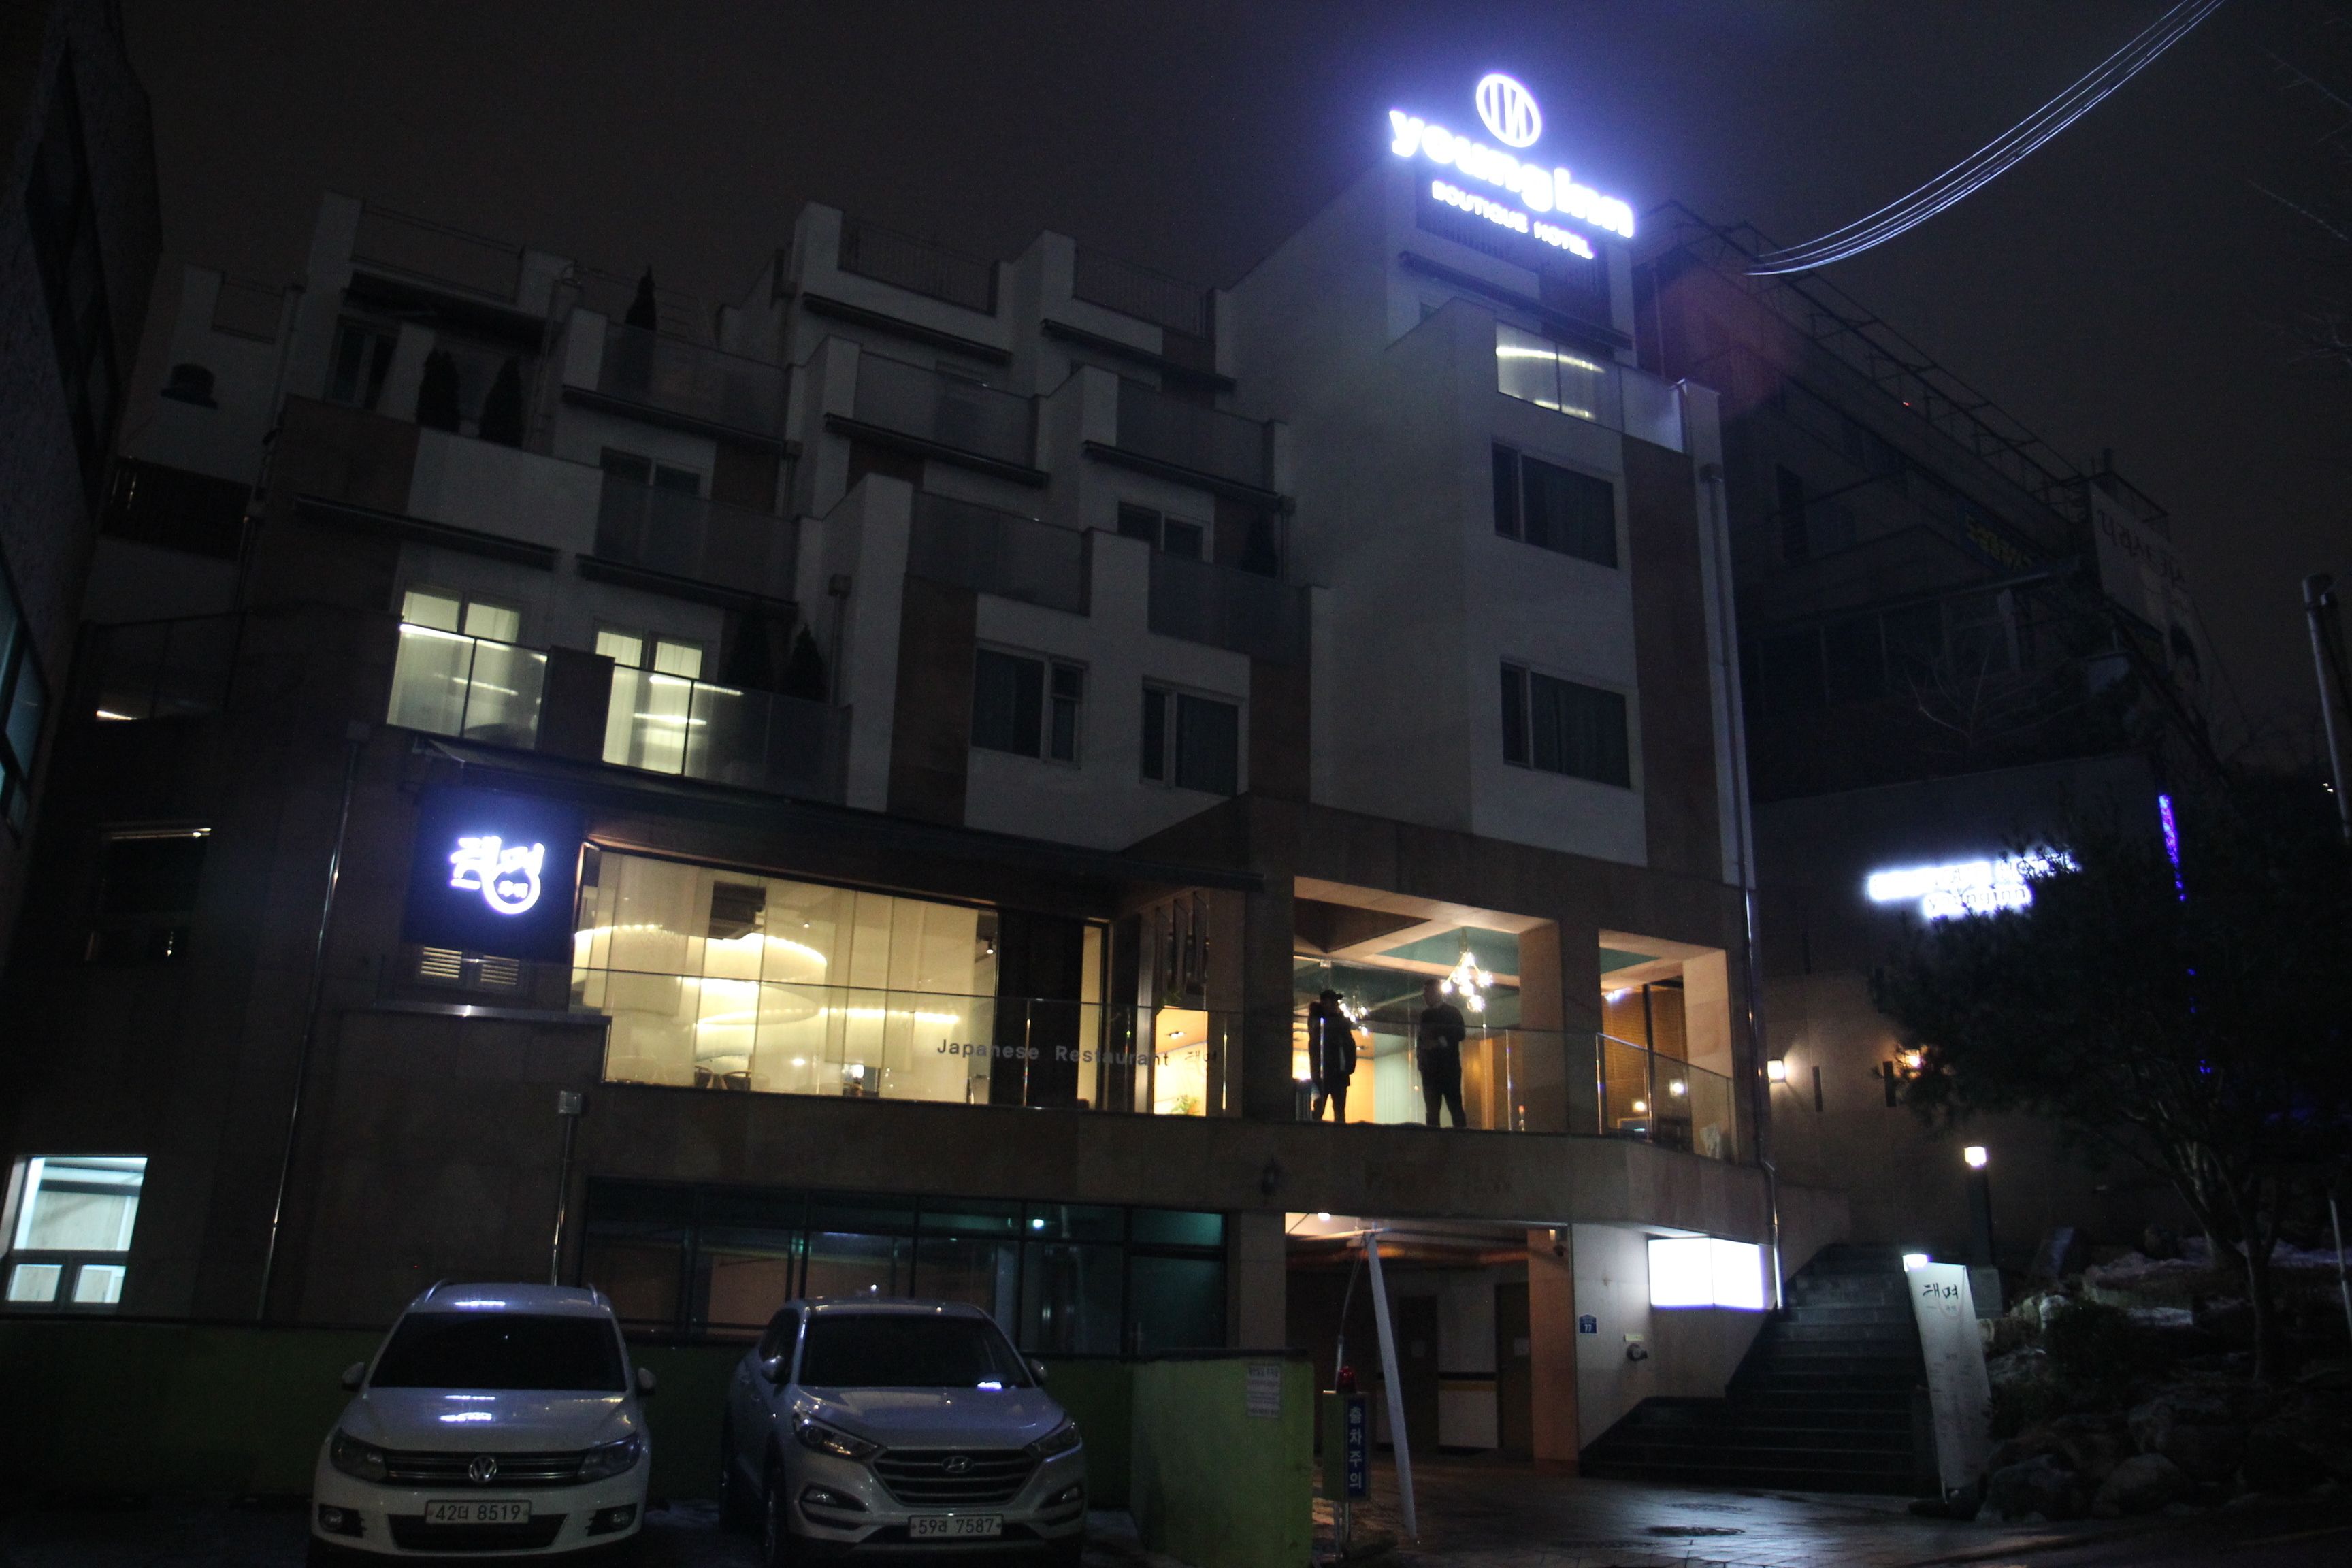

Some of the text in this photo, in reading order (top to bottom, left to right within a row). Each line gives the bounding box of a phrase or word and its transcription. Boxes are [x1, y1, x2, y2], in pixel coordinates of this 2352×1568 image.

[1431, 180, 1595, 259] BOUTIQUE HOTEL
[937, 1039, 1169, 1066] Japanese Restaurant
[1349, 1405, 1362, 1489] 출차주의
[436, 1505, 521, 1521] 42더 8519
[956, 1518, 994, 1533] 7587
